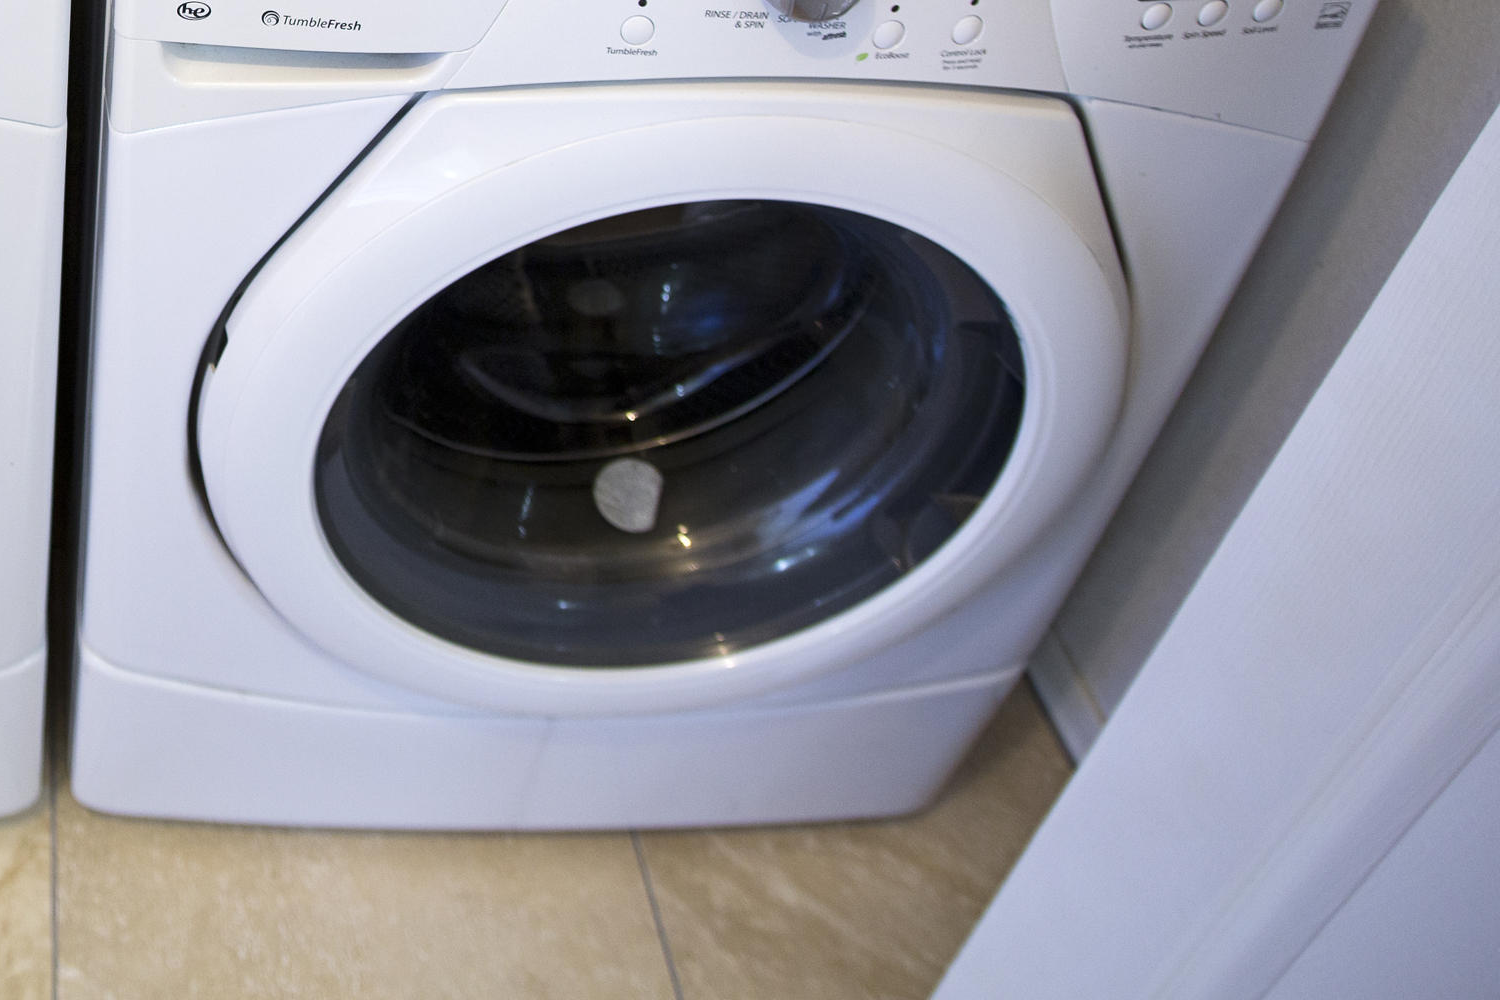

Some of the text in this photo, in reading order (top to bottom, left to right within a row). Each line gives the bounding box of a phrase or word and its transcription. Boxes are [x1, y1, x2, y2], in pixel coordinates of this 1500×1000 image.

[179, 2, 208, 19] he
[705, 10, 732, 19] RINSE
[740, 11, 769, 20] DRAIN
[283, 14, 362, 32] TumbleFresh
[735, 21, 765, 29] & SPIN
[607, 47, 658, 56] TumbleFresh
